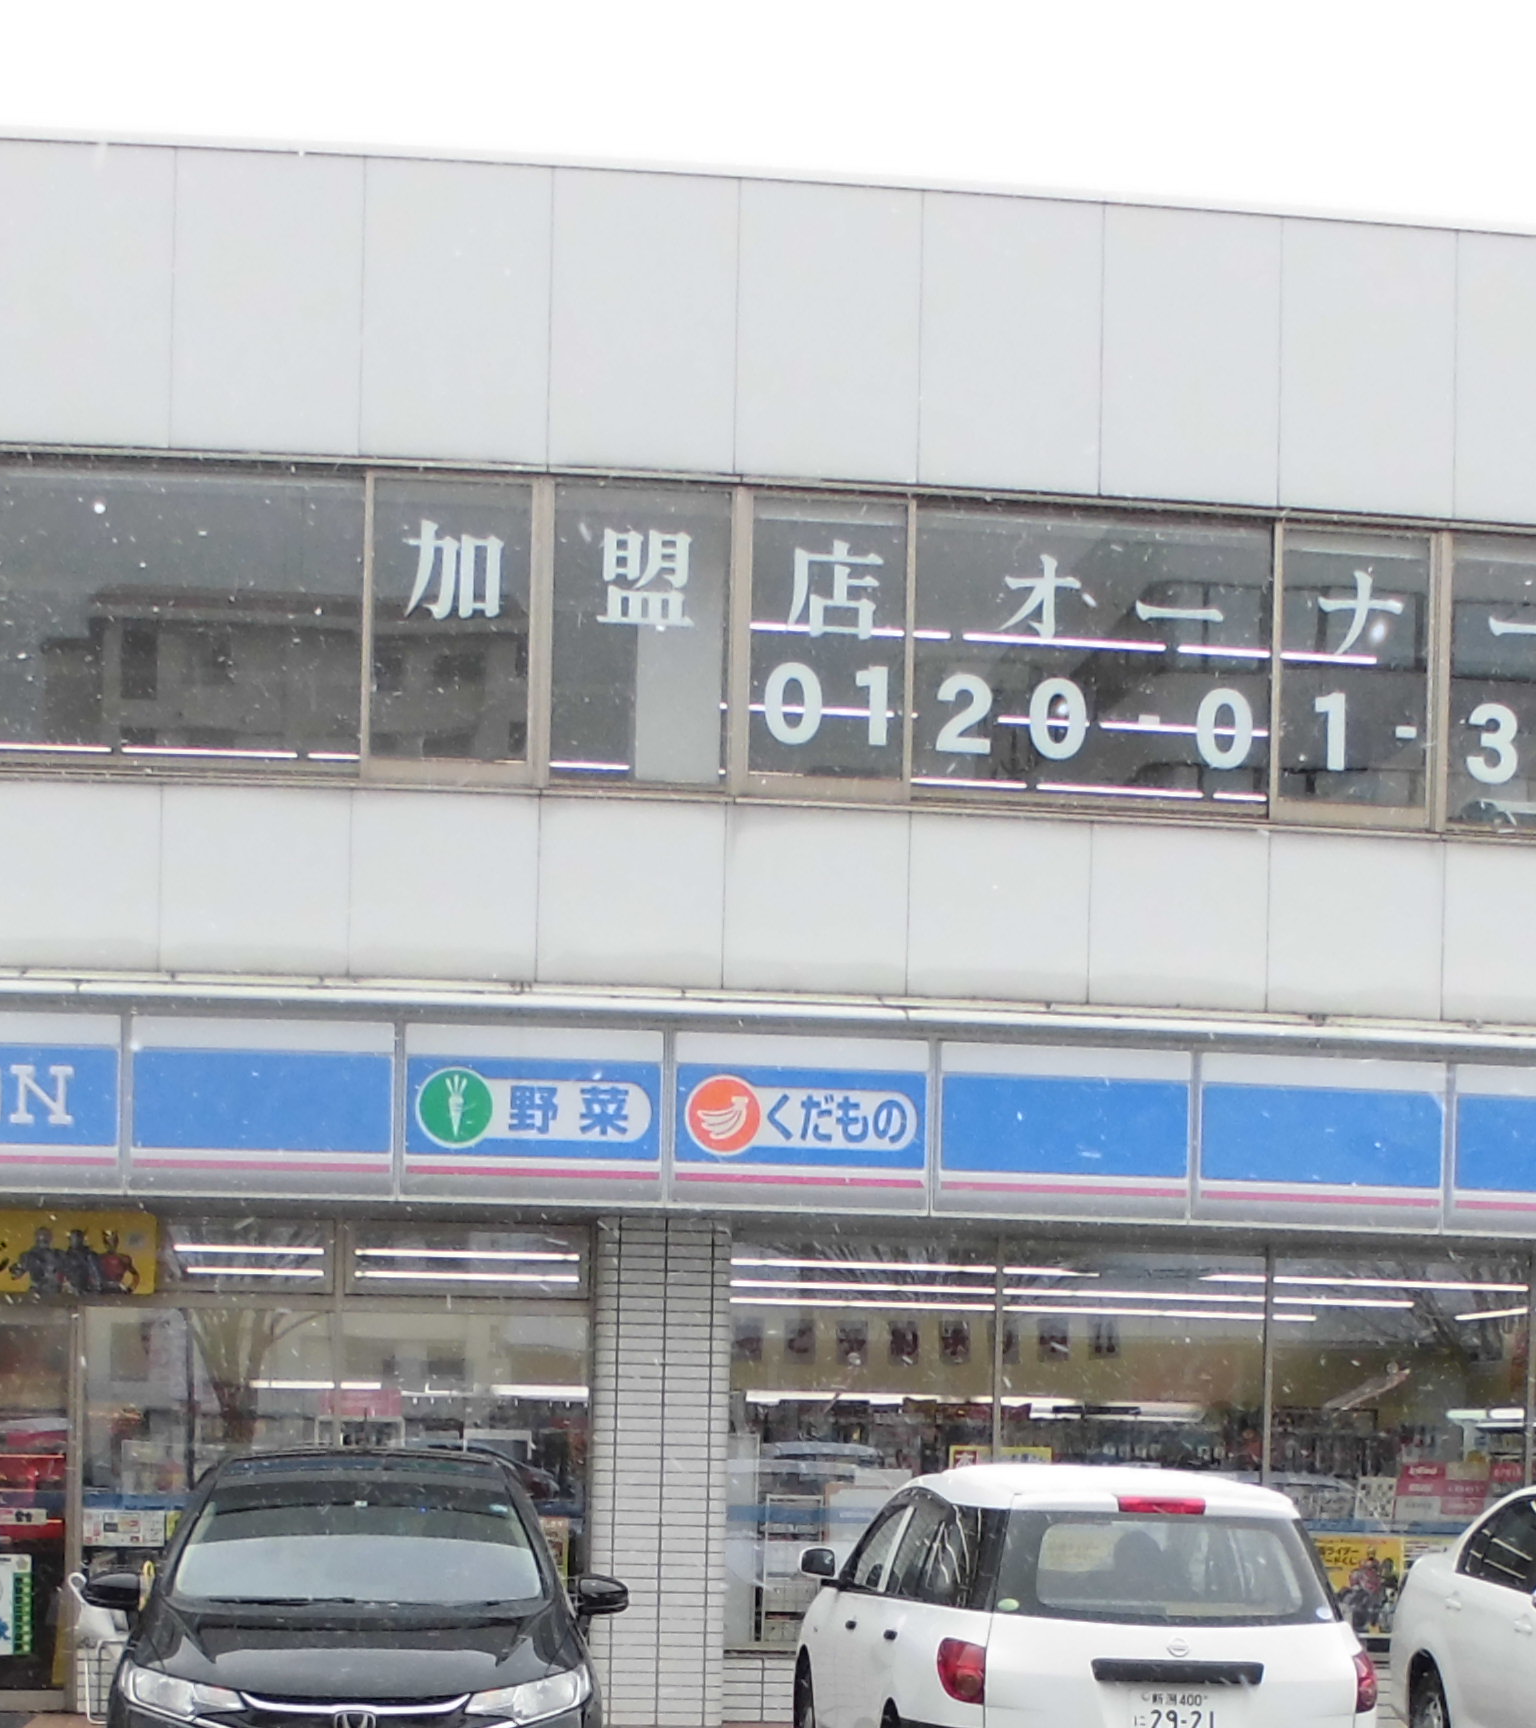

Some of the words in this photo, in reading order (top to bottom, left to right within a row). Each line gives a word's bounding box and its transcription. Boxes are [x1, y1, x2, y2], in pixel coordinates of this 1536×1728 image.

[507, 1082, 631, 1136] 野菜
[766, 1092, 909, 1145] くだもの
